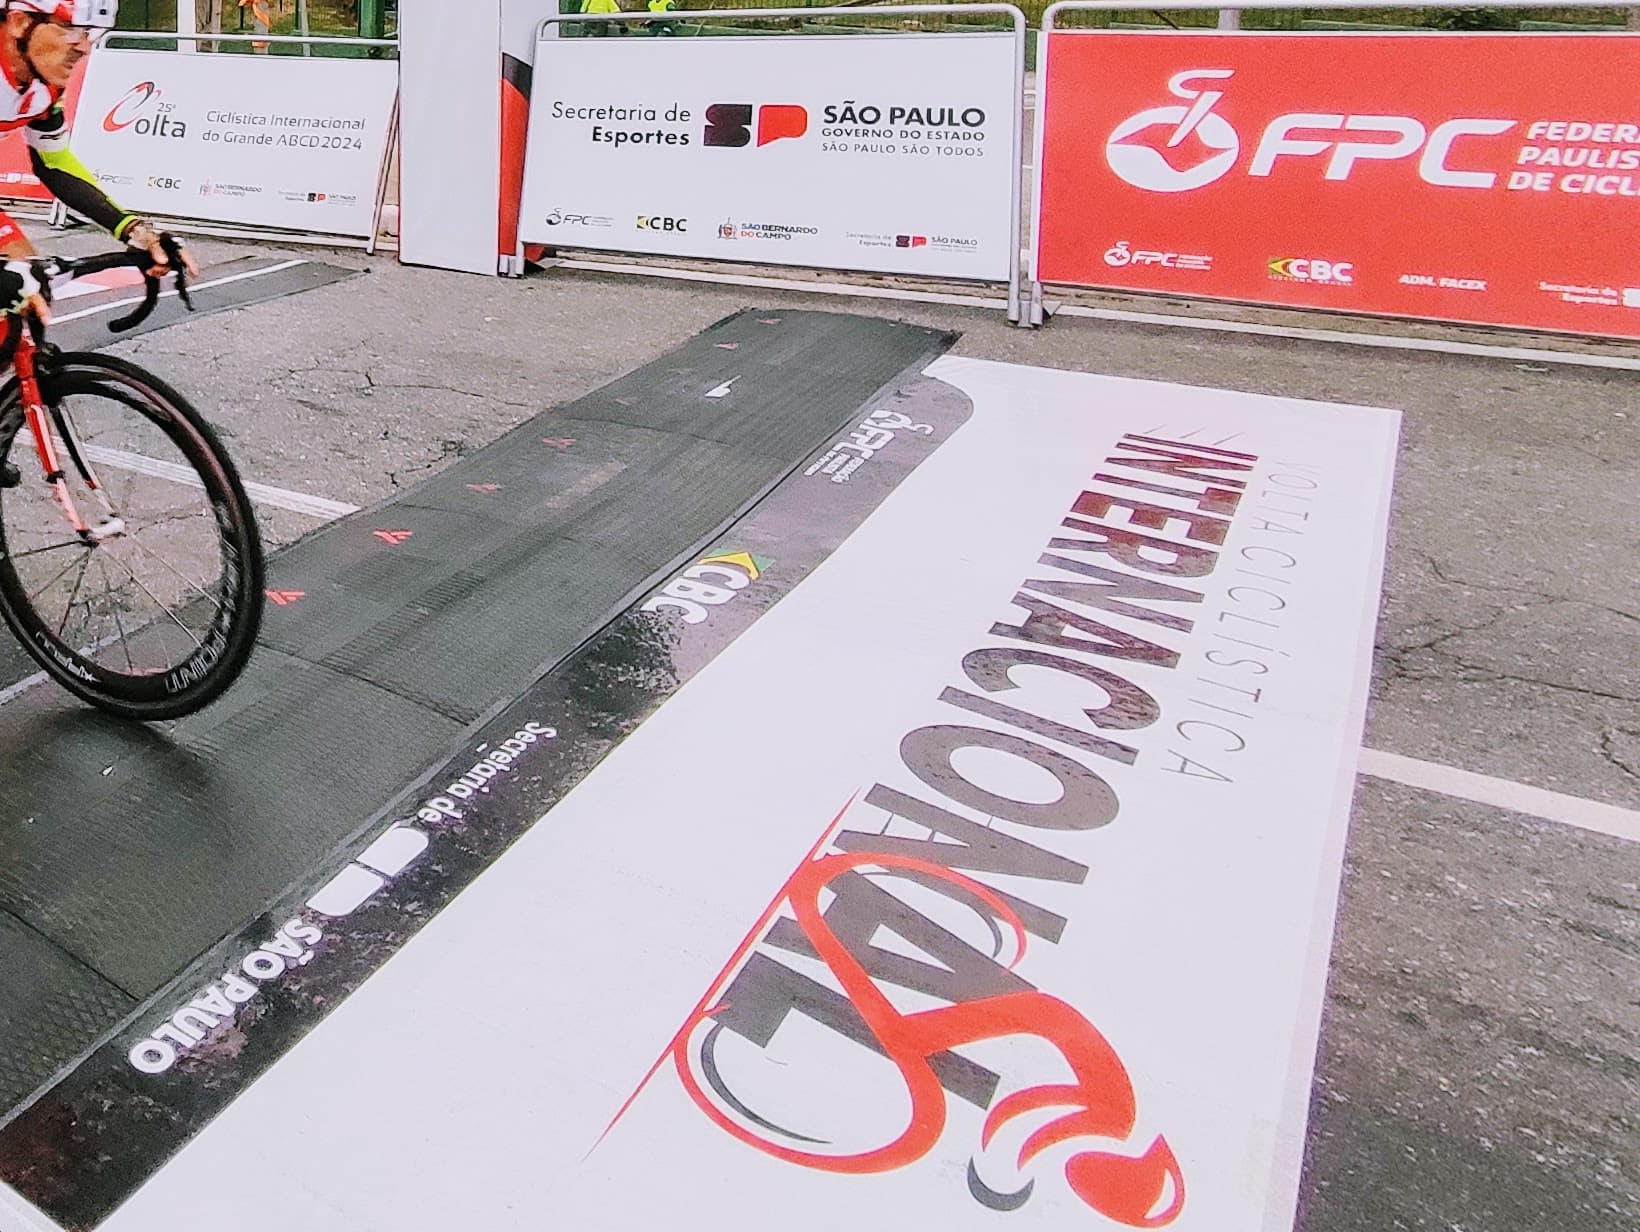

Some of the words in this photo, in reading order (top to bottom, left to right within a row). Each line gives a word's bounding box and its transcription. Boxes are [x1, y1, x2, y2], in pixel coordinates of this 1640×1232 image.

[206, 110, 267, 127] Ciclística
[270, 114, 367, 132] Internacional
[551, 99, 658, 123] Secretaria
[664, 101, 692, 123] de
[822, 100, 882, 126] SÃO
[889, 106, 987, 128] PAULO
[202, 130, 220, 144] do
[223, 132, 273, 146] Grande
[591, 125, 691, 149] Esportes
[821, 126, 895, 141] GOVERNO
[900, 129, 923, 141] DO
[926, 129, 986, 142] ESTADO
[1526, 120, 1640, 145] FEDER
[821, 139, 849, 153] SÃO
[852, 142, 896, 155] PAULO
[901, 141, 930, 156] SÃO
[936, 144, 985, 157] TODOS
[1247, 112, 1518, 189] FPC
[156, 177, 183, 190] CBC
[1507, 170, 1555, 192] DE
[562, 215, 592, 226] FPC
[649, 217, 688, 232] CBC
[761, 224, 819, 235] BERNARDO
[755, 231, 792, 241] CAMPO
[1131, 250, 1179, 268] FPC
[1289, 258, 1353, 282] CBC
[639, 564, 751, 625] CBC
[1160, 545, 1298, 784] CICLÍSTICA
[446, 722, 558, 799] Secretaria
[709, 432, 1260, 1111] INTERNACIONAL
[417, 797, 463, 823] de
[242, 917, 323, 981] SÃO
[128, 972, 259, 1074] PAULO
